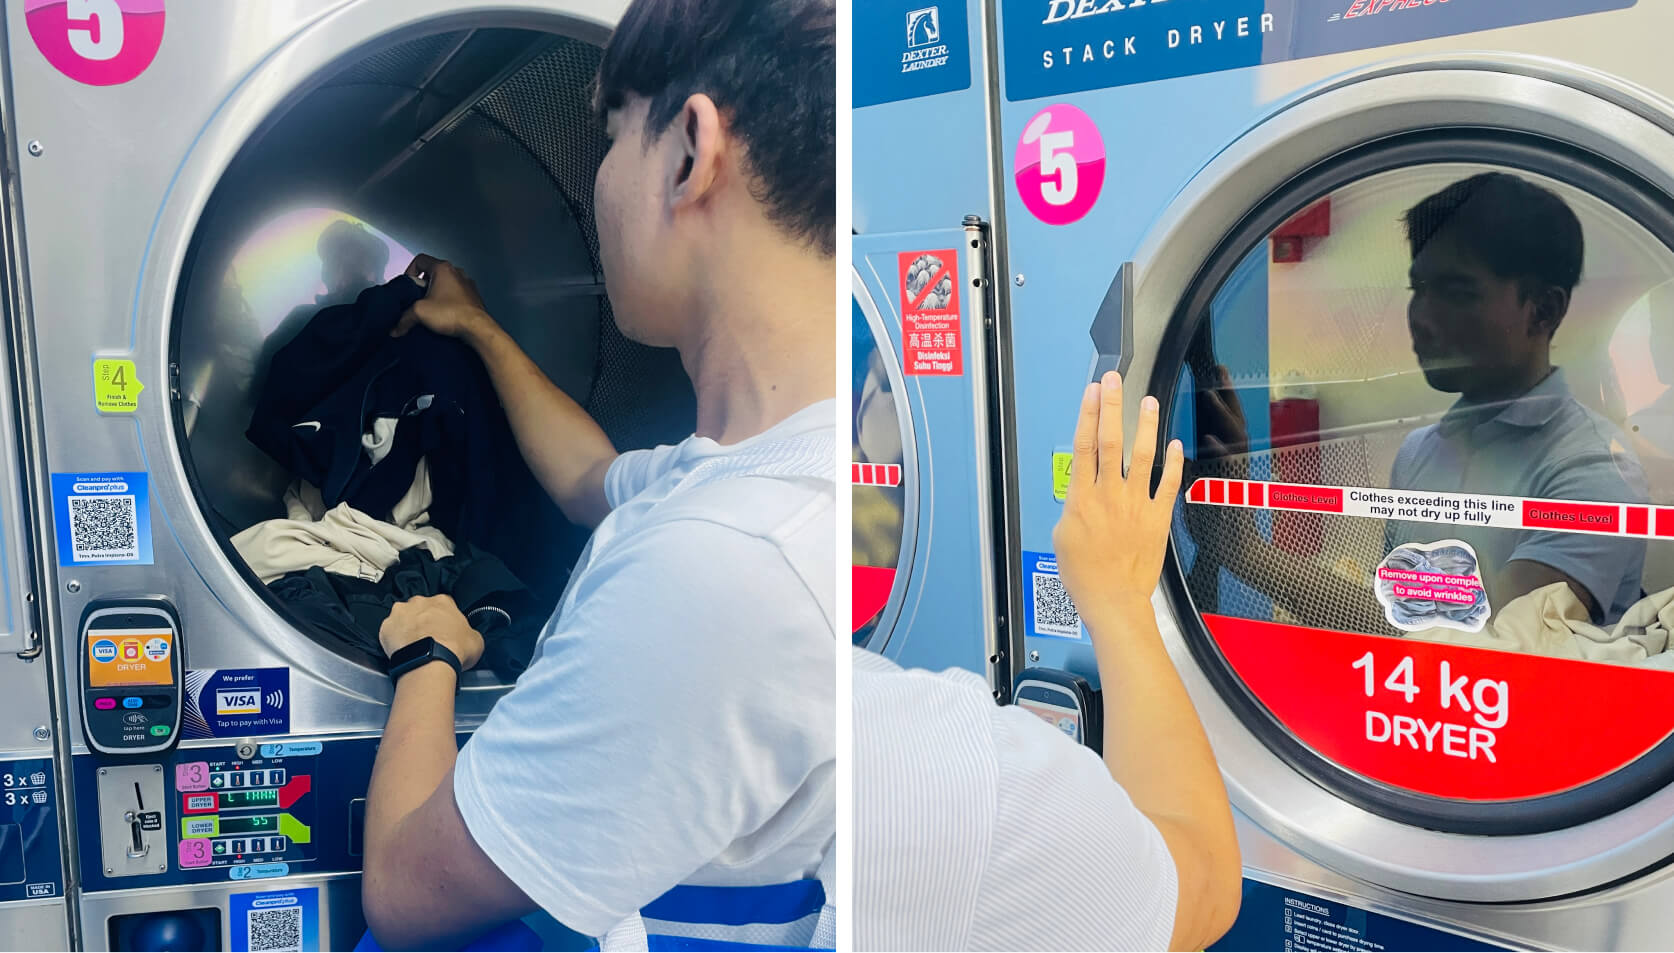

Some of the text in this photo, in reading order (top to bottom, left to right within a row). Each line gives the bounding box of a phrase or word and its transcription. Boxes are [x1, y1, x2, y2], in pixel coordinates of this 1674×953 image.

[66, 0, 124, 61] 5
[1042, 13, 1274, 69] STACK DRYER
[901, 45, 948, 63] DEXTER
[901, 56, 949, 73] LAUNDRY
[1040, 130, 1079, 206] 5
[905, 313, 958, 324] High-Temperature
[915, 321, 949, 330] Disinfection
[908, 332, 956, 348] 高温杀菌
[917, 351, 950, 361] Disinfeksi
[913, 361, 953, 372] Suhu Tinggi
[111, 365, 127, 391] 4
[1272, 491, 1337, 505] Clothes Level
[1350, 491, 1515, 512] Clothes exceeding this line
[1370, 506, 1491, 525] may not dry up fully
[1529, 508, 1613, 525] Clothes Level
[1380, 569, 1418, 581] Remove
[1419, 574, 1443, 585] upon
[1395, 586, 1473, 602] to avoid wrinkles
[117, 663, 146, 672] DRYER
[234, 674, 255, 682] prefer
[1352, 651, 1509, 729] 14 kg
[224, 695, 256, 707] VISA
[217, 720, 229, 728] Tap
[239, 720, 251, 728] pay
[1366, 710, 1497, 763] DRYER
[275, 743, 284, 756] 2
[3, 773, 28, 787] 3 x
[190, 764, 202, 783] 3
[5, 792, 29, 806] 3 x
[193, 841, 205, 859] 3
[243, 866, 251, 878] 2
[1284, 897, 1329, 915] INSTRUCTIONS
